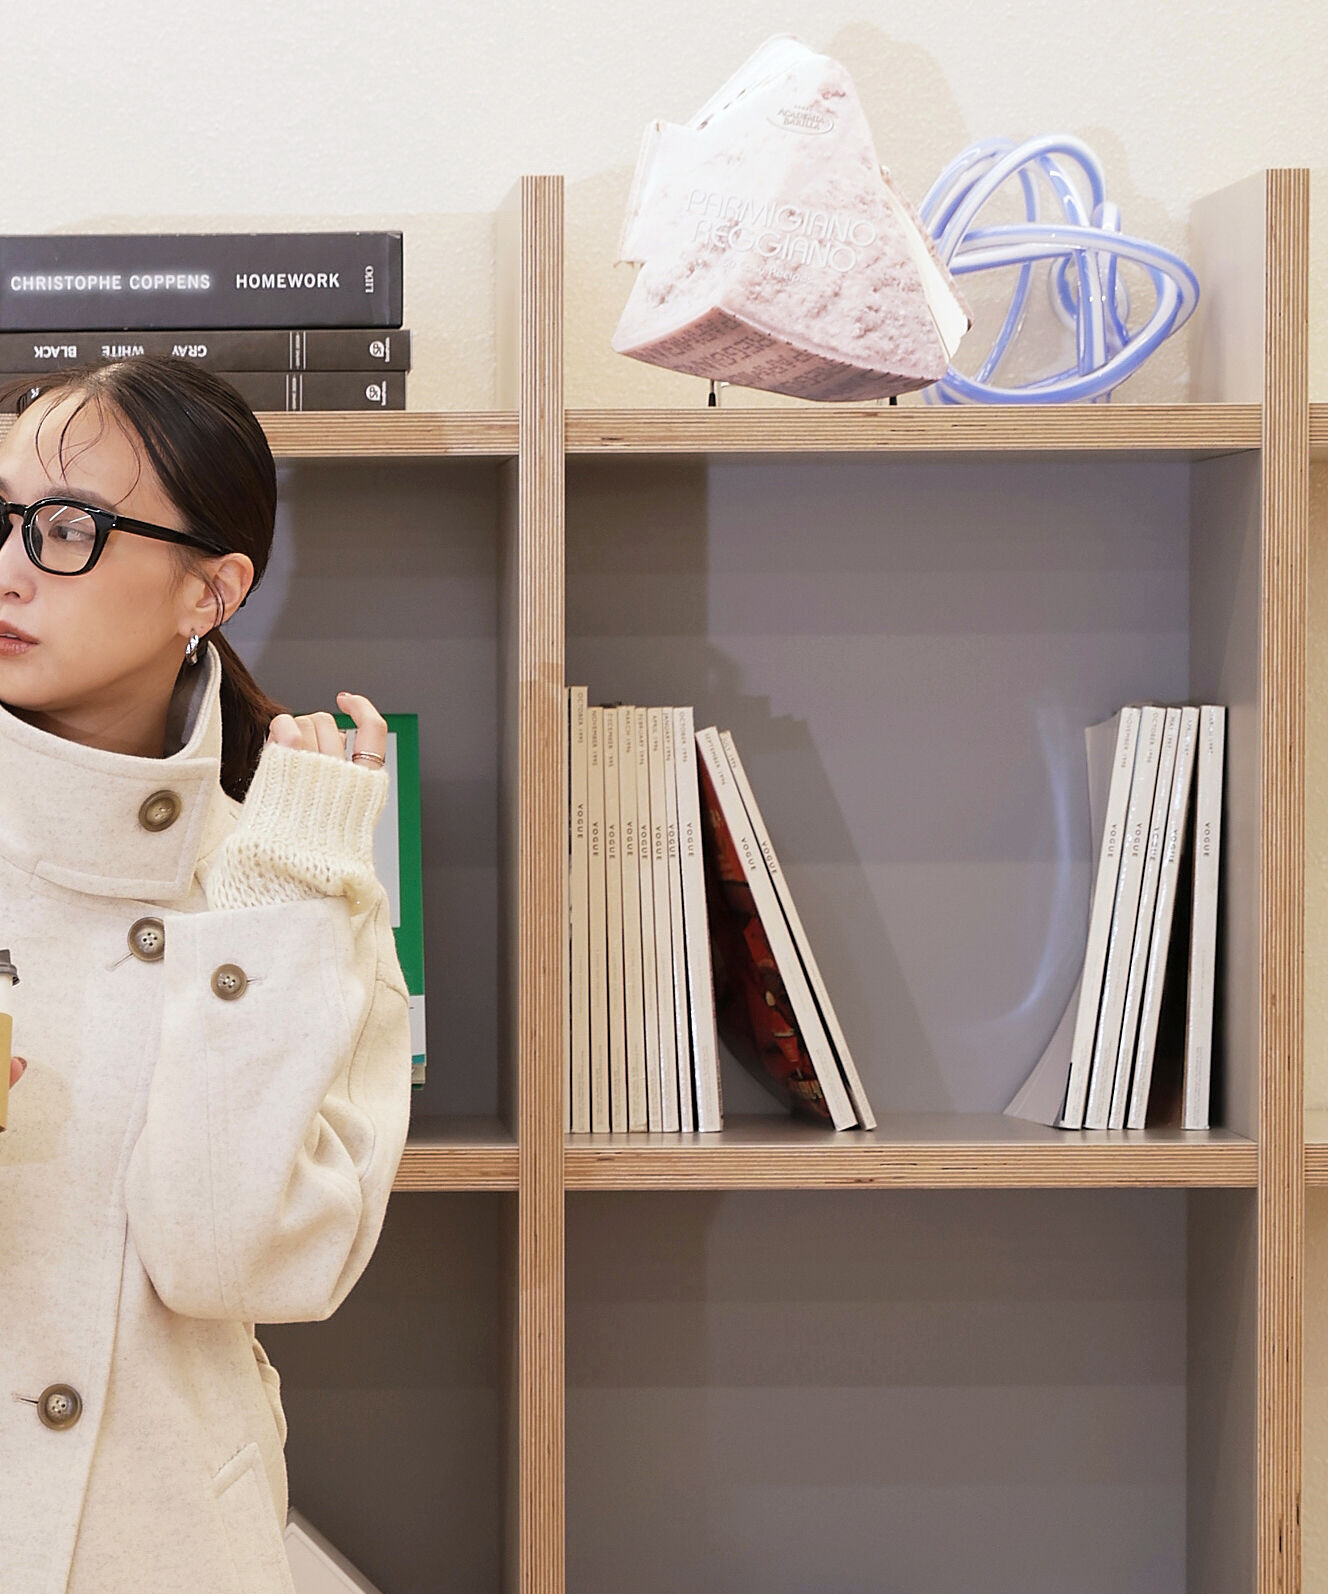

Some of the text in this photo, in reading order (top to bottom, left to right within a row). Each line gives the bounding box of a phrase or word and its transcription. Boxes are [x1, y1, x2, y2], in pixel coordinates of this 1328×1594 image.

[686, 188, 877, 248] PARMIGIANO
[692, 219, 857, 273] REGGIANO
[10, 272, 341, 291] CHRISTOPHE COPPENS HOMEWORK
[34, 345, 208, 359] GRAY WHITE BLACK
[592, 821, 600, 857] VOGUE
[608, 824, 616, 860] VOGUE
[626, 821, 634, 857] VOGUE
[640, 824, 648, 860] VOGUE
[655, 825, 663, 860] VOGUE
[668, 823, 676, 859] VOGUE
[686, 822, 695, 857] VOGUE
[740, 836, 757, 871] VOGUE
[1107, 823, 1117, 858] VOGUE
[1131, 823, 1143, 857] VOGUE
[1168, 829, 1177, 863] VOGUE
[1203, 822, 1211, 857] VOGUE
[761, 840, 778, 875] VOGUE
